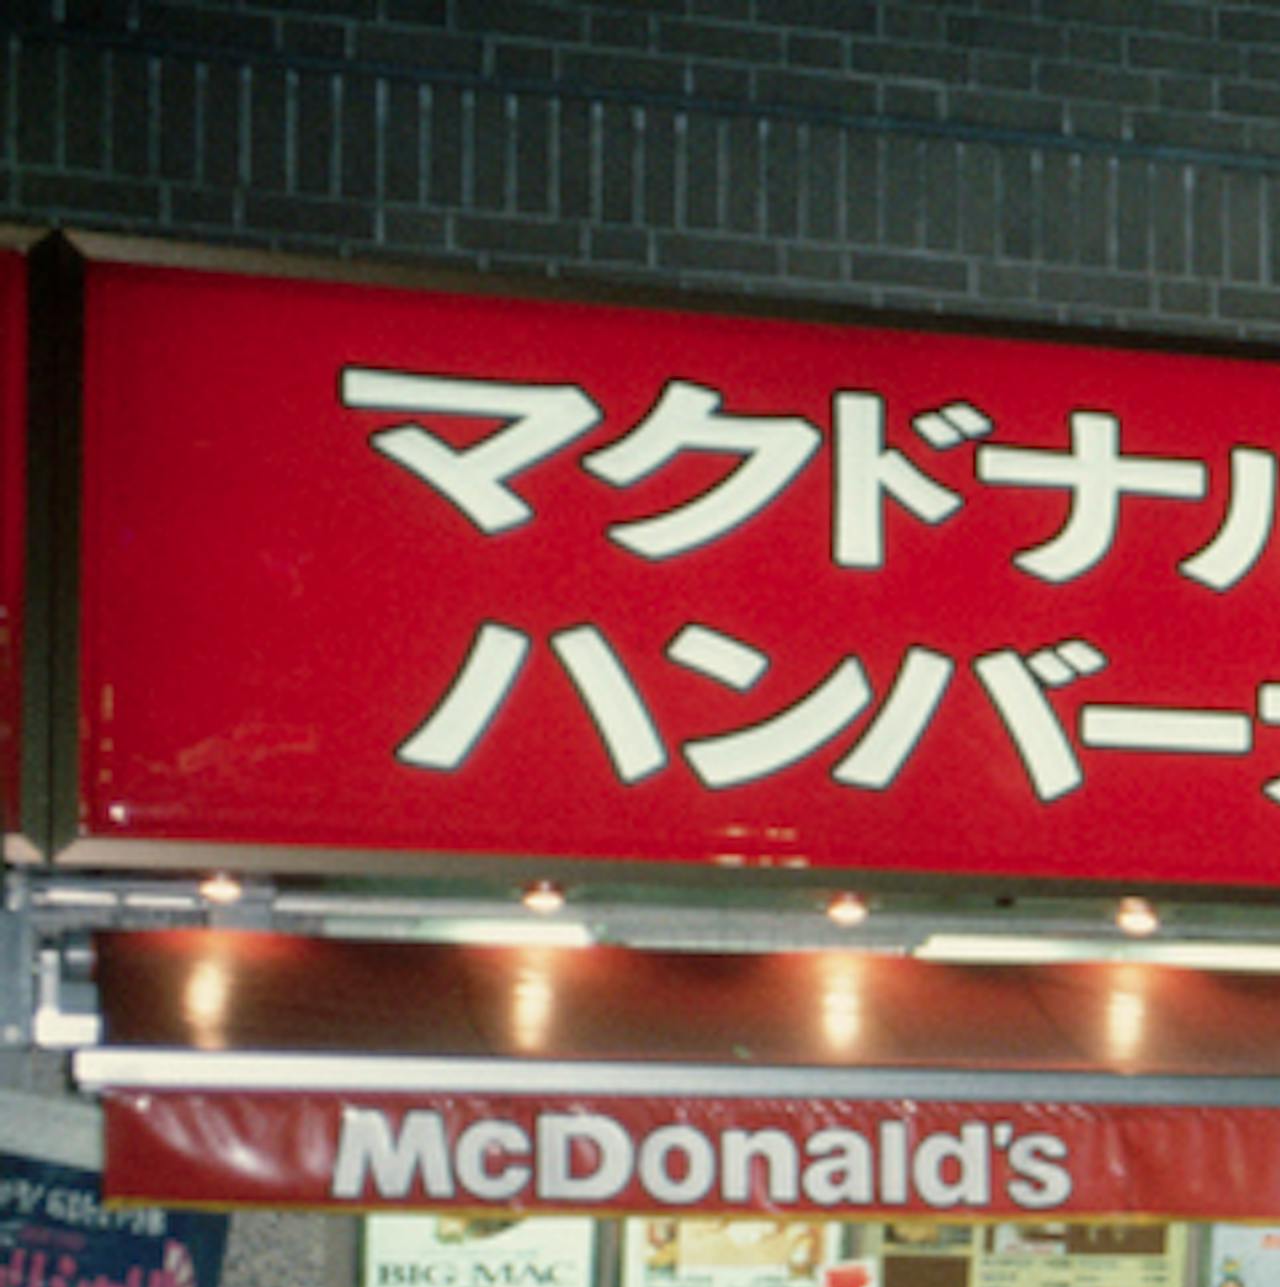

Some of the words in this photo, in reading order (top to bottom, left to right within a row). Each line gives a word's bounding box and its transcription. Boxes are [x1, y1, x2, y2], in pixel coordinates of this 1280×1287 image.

[331, 1107, 1072, 1209] McDonald's
[377, 1262, 457, 1286] BIG
[472, 1261, 576, 1287] MAC
